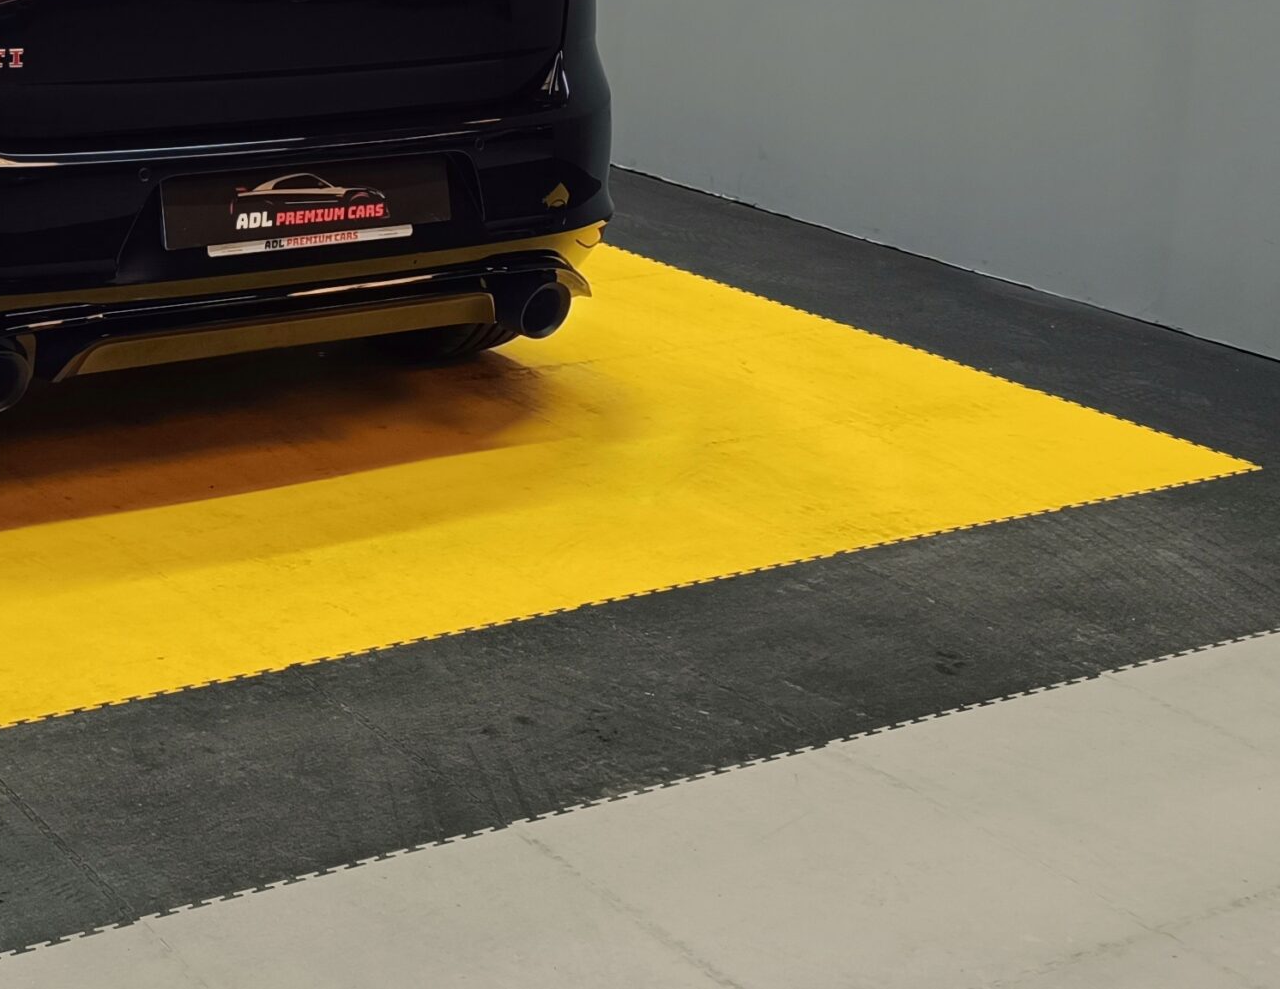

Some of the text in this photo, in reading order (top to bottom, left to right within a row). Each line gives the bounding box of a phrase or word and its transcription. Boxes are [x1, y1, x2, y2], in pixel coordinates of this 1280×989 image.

[235, 203, 384, 230] ADL PREMIUM CARS
[264, 231, 359, 250] ADL PREMIUM CARS
